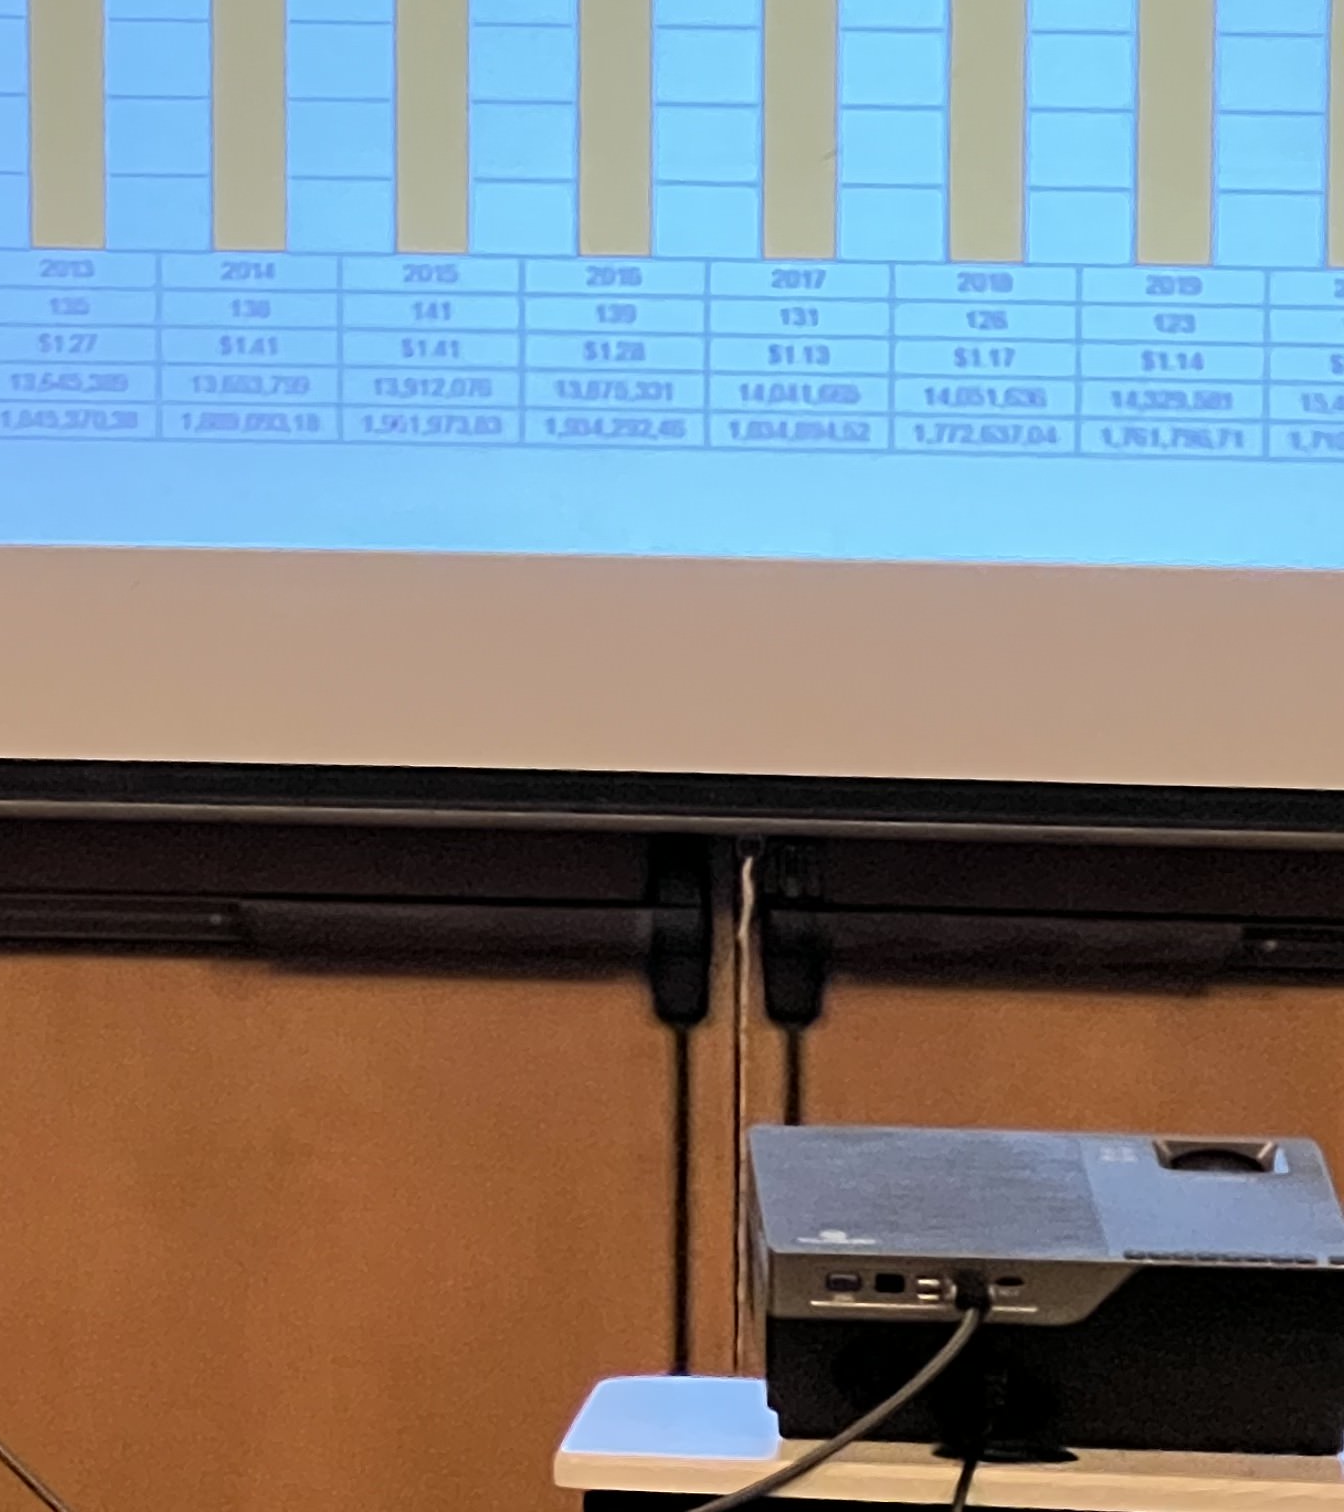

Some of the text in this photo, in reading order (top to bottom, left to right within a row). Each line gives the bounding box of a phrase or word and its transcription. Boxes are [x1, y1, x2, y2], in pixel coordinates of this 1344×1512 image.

[40, 259, 95, 278] 2013
[221, 261, 275, 280] 2014
[403, 264, 459, 284] 2015
[586, 266, 642, 286] 2016
[771, 269, 826, 289] 2017
[412, 302, 451, 320] 141
[780, 307, 818, 327] 131
[1141, 350, 1204, 371] $1.14
